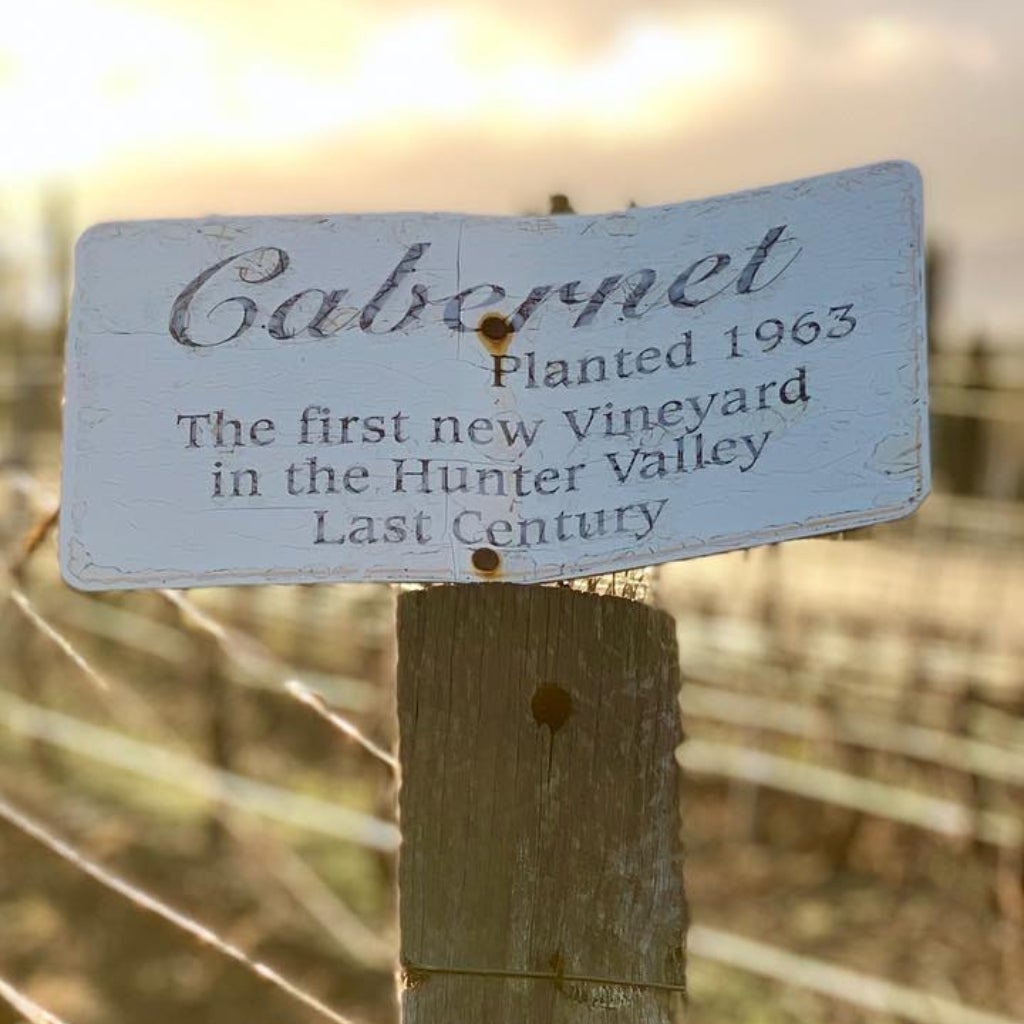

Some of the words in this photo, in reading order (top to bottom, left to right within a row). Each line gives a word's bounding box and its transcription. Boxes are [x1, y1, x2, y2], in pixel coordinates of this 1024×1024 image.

[168, 223, 805, 349] Cabernet
[490, 331, 694, 390] Planted
[723, 303, 858, 360] 1963
[176, 410, 276, 450] The
[297, 406, 412, 446] first
[432, 411, 540, 448] new
[563, 367, 813, 442] Vineyard
[211, 461, 262, 500] in
[285, 457, 371, 497] the
[392, 458, 587, 498] Hunter
[603, 429, 775, 486] Valley
[312, 508, 434, 547] Last
[452, 498, 670, 549] Century
